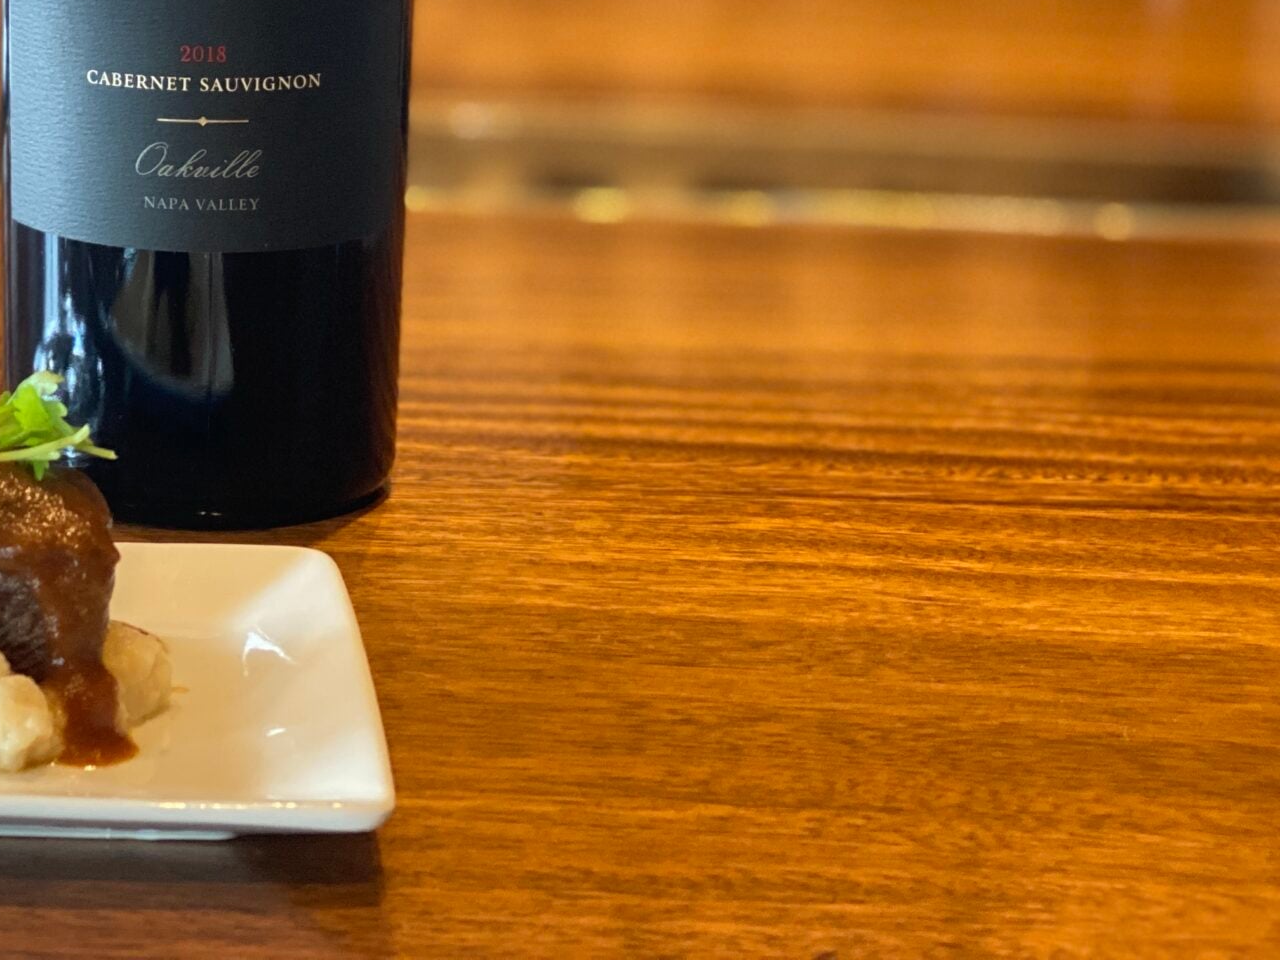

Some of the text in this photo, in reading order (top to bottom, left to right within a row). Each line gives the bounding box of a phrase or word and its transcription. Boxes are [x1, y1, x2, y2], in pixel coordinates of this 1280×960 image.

[179, 44, 228, 64] 2018
[85, 69, 323, 93] CABERNET SAUVIGNON
[134, 141, 263, 180] Oakville
[143, 195, 261, 212] NAPA VALLEY
